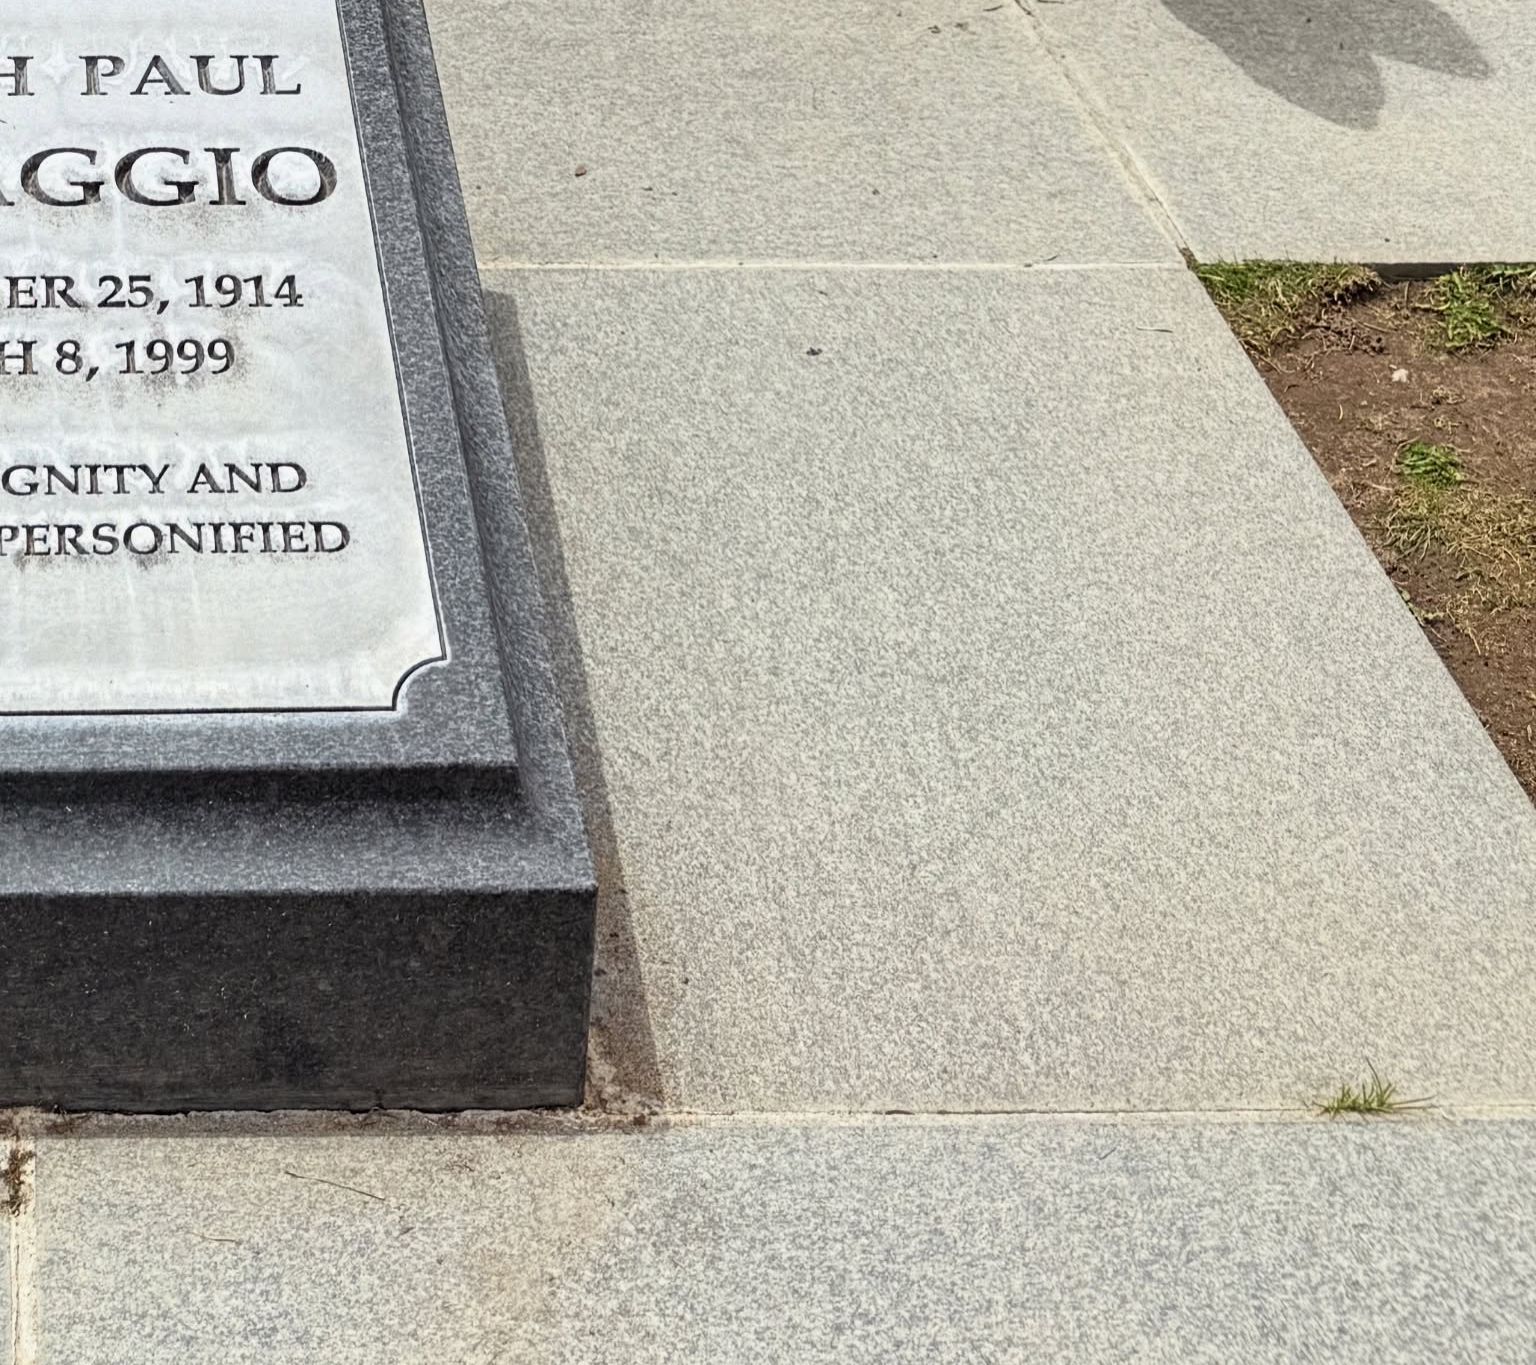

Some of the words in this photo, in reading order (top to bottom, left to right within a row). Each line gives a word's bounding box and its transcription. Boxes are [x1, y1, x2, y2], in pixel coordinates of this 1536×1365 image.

[80, 56, 300, 95] PAUL
[98, 276, 169, 314] 25,
[185, 275, 302, 307] 1914
[56, 340, 98, 381] 8,
[116, 339, 234, 374] 1999
[187, 463, 306, 493] AND
